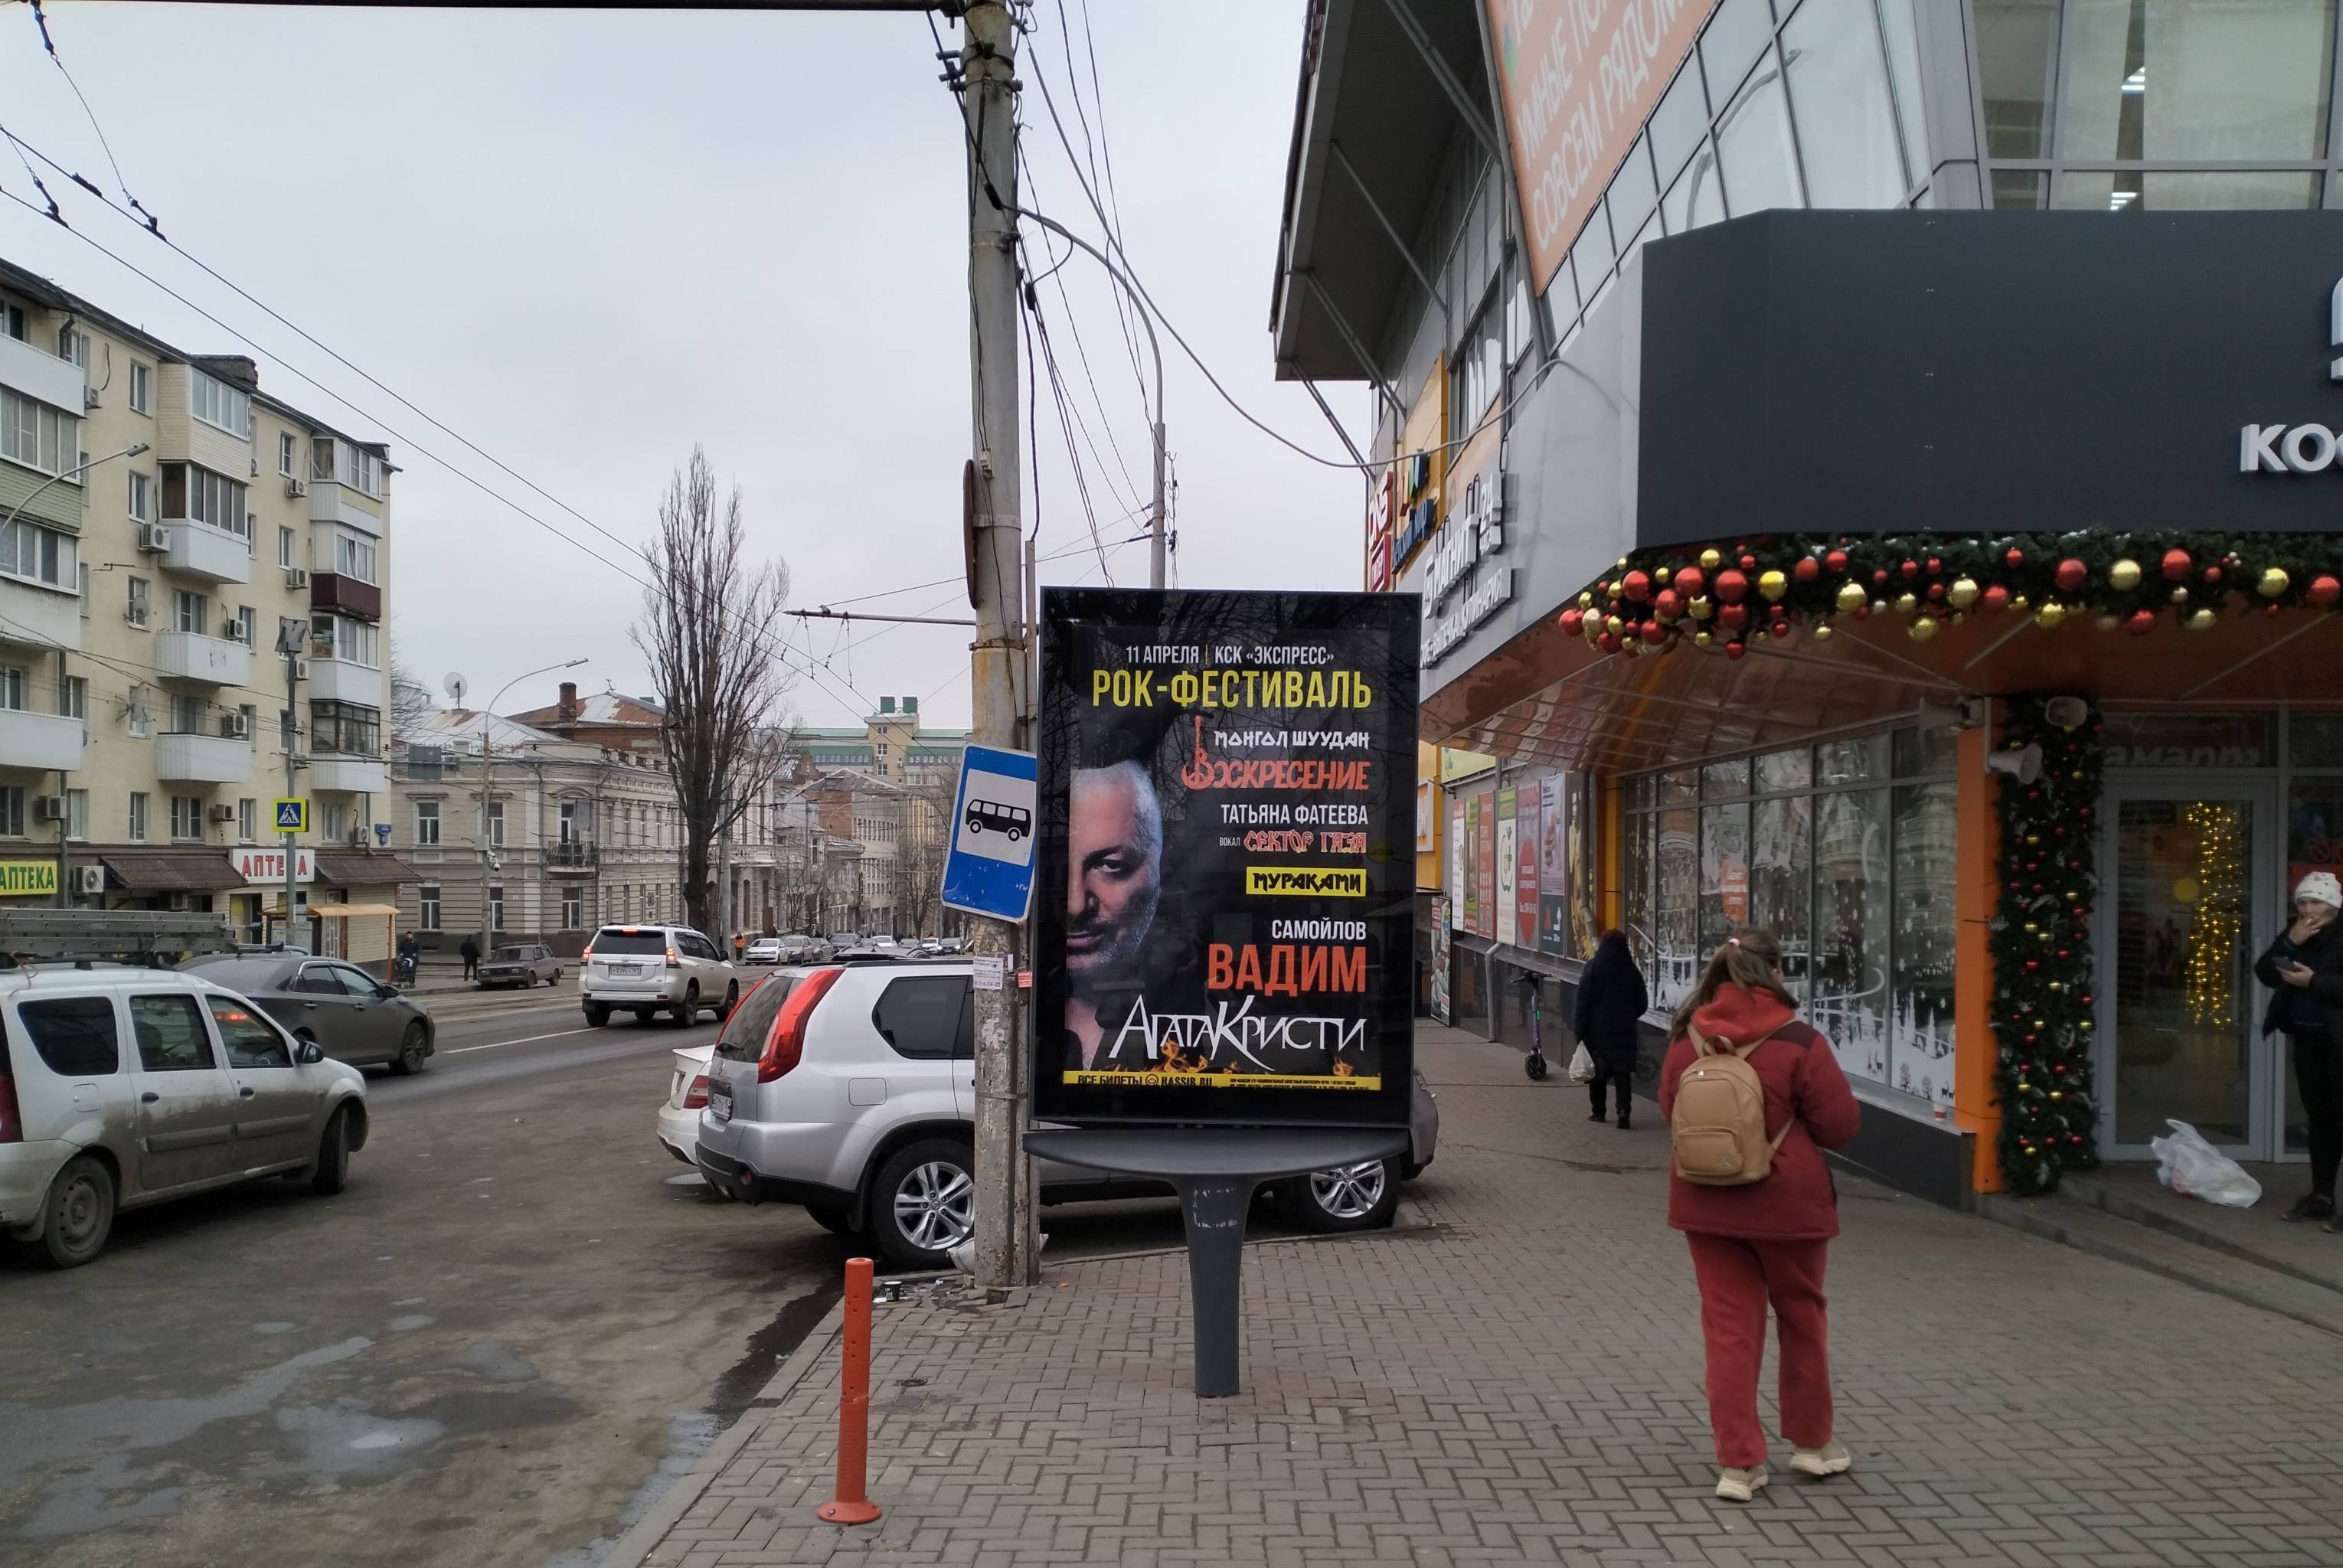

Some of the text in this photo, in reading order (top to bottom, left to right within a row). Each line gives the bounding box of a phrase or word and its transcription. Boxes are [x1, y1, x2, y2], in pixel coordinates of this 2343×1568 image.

[1517, 17, 1573, 170] УМНЫЕ
[1533, 81, 1603, 250] СОВСЕМ
[2240, 423, 2343, 473] КО
[1434, 514, 1479, 600] МАГНИТ
[1126, 645, 1334, 665] 11 АПРЕЛЯ КСК «ЭКСПРЕСС»
[1092, 669, 1371, 708] РОК-ФЕСТИВАЛЬ
[1292, 731, 1370, 750] ШУУДАН
[1181, 733, 1371, 790] ВОСКРЕСЕНИЕ
[1221, 804, 1368, 825] ТАТЬЯНА ФАТЕЕВА
[1219, 829, 1367, 854] ВОКАЛ СЕКТОР ГАЗА
[0, 866, 54, 890] АПТЕКА
[241, 855, 307, 877] АПТЕА
[1252, 872, 1361, 893] МУРАКАМИ
[1272, 916, 1366, 940] САМОЙЛОВ
[1207, 943, 1366, 997] ВАДИМ
[1077, 1074, 1142, 1086] ВСЕ БИЛЕТЫ
[1161, 1076, 1212, 1086] KASSIRRU
